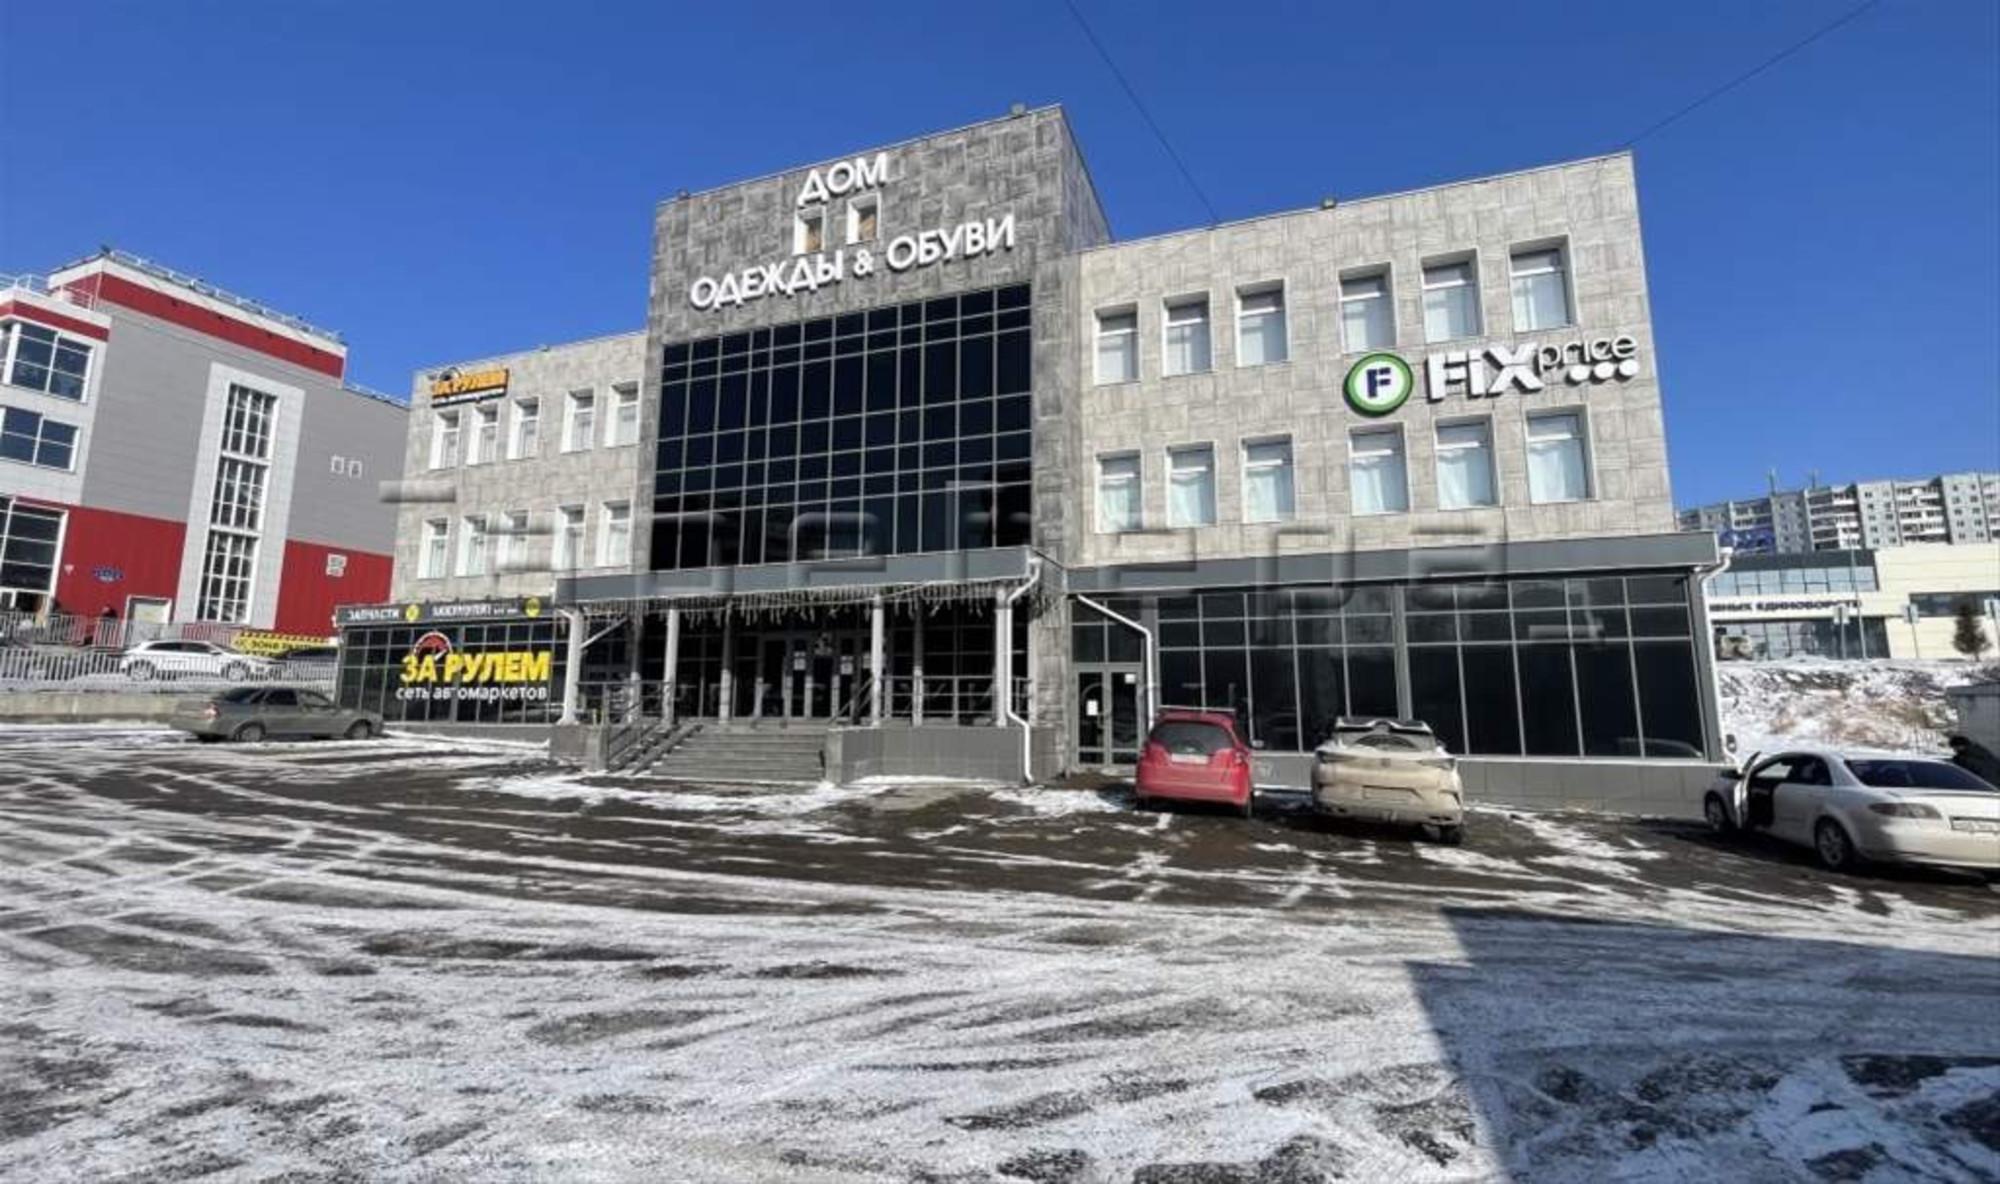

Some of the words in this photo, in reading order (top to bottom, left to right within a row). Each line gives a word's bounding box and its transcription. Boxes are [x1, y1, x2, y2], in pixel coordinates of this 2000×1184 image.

[799, 152, 888, 206] ДОМ
[690, 249, 843, 310] ОДЕЖДЫ
[853, 248, 875, 276] &
[886, 214, 1014, 271] ОБУВИ
[348, 608, 400, 621] ЗАПЧАСТИ
[401, 655, 437, 683] ЗА
[444, 651, 550, 682] РУЛЕМ
